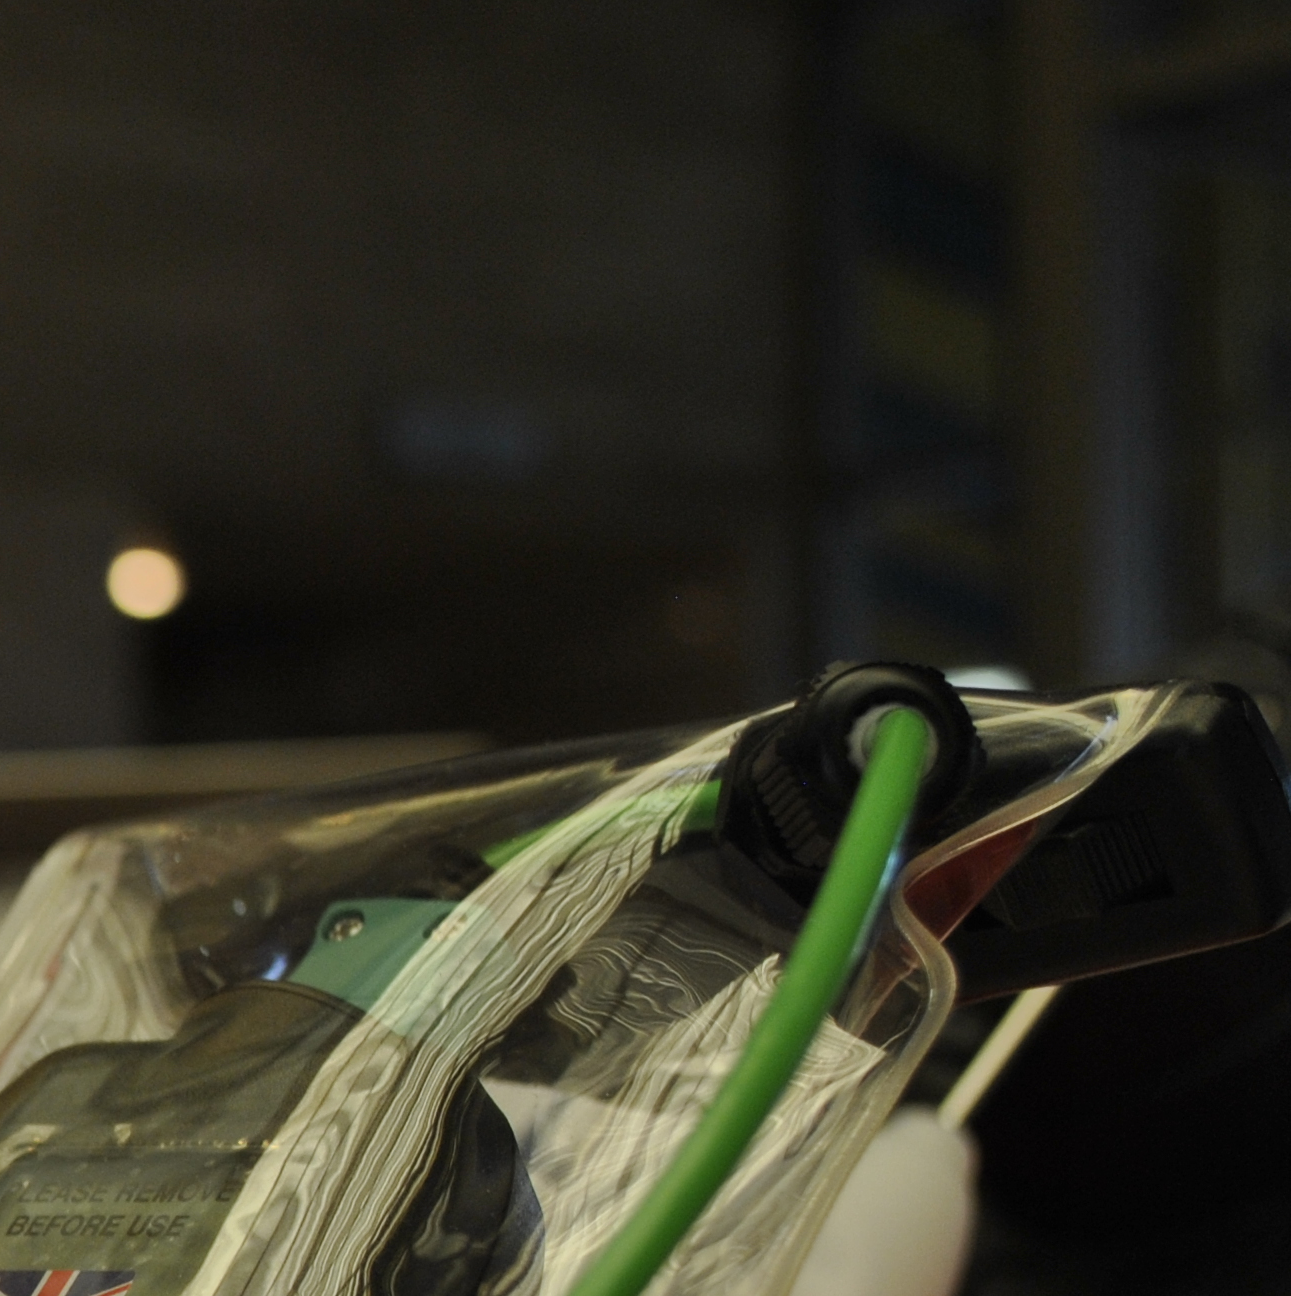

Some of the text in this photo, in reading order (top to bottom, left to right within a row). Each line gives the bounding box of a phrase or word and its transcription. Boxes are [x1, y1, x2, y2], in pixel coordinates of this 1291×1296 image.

[7, 1180, 239, 1205] PLEASE REMOVE
[5, 1214, 191, 1239] BEFORE USE
